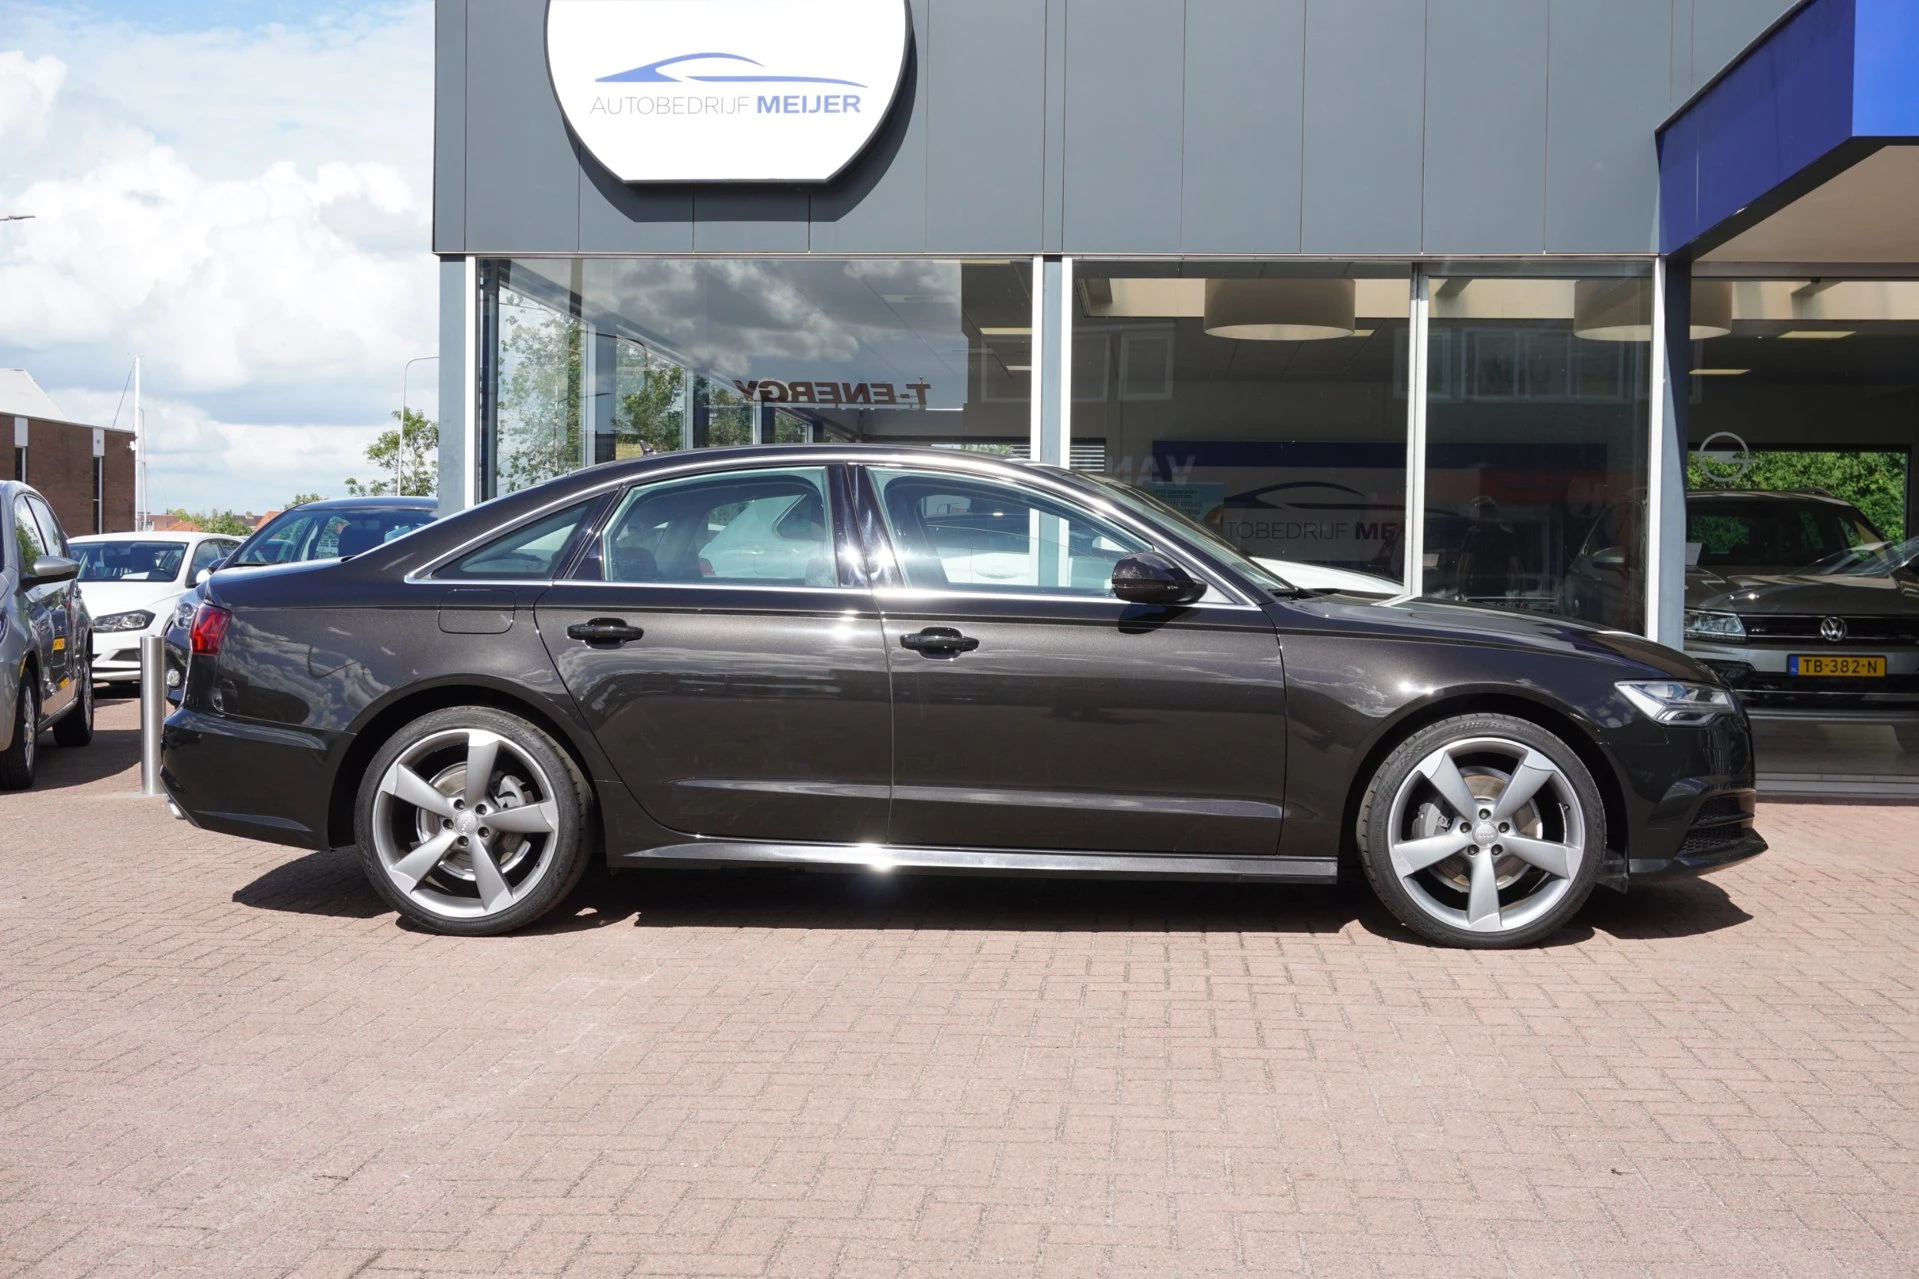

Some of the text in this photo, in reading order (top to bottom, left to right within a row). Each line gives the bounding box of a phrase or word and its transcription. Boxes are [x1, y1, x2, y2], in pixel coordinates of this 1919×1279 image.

[591, 95, 861, 114] AUTOBEDRIJF MEIJER
[1224, 522, 1350, 541] TOBEDRIJF
[1803, 660, 1877, 674] TB-382-N
